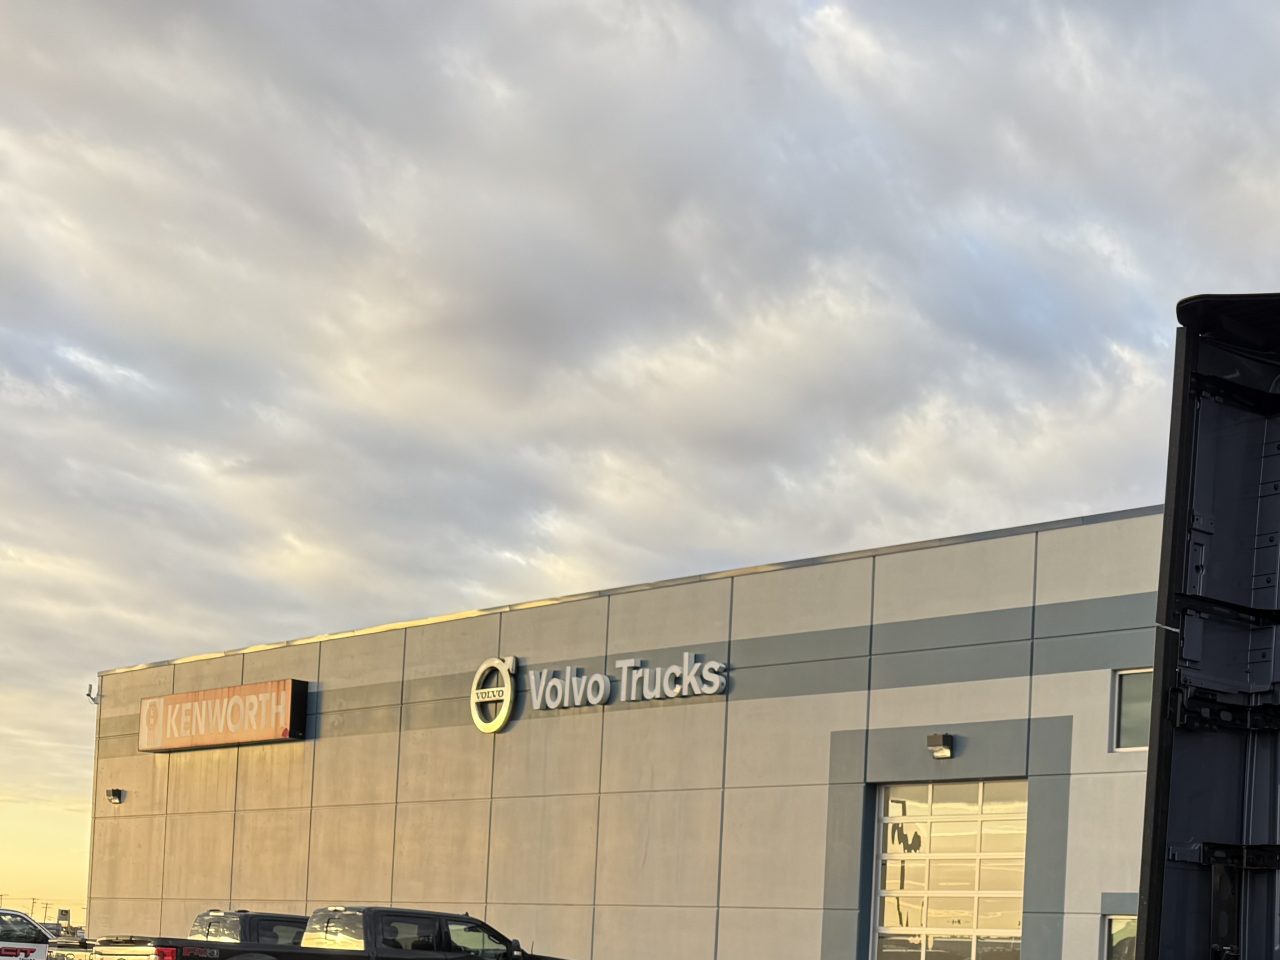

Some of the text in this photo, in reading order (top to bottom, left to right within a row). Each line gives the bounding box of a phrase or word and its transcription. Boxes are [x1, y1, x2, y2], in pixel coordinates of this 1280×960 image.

[475, 689, 505, 699] VOLVO
[529, 651, 727, 710] Volvo Trucks
[166, 690, 287, 739] KENWORTH
